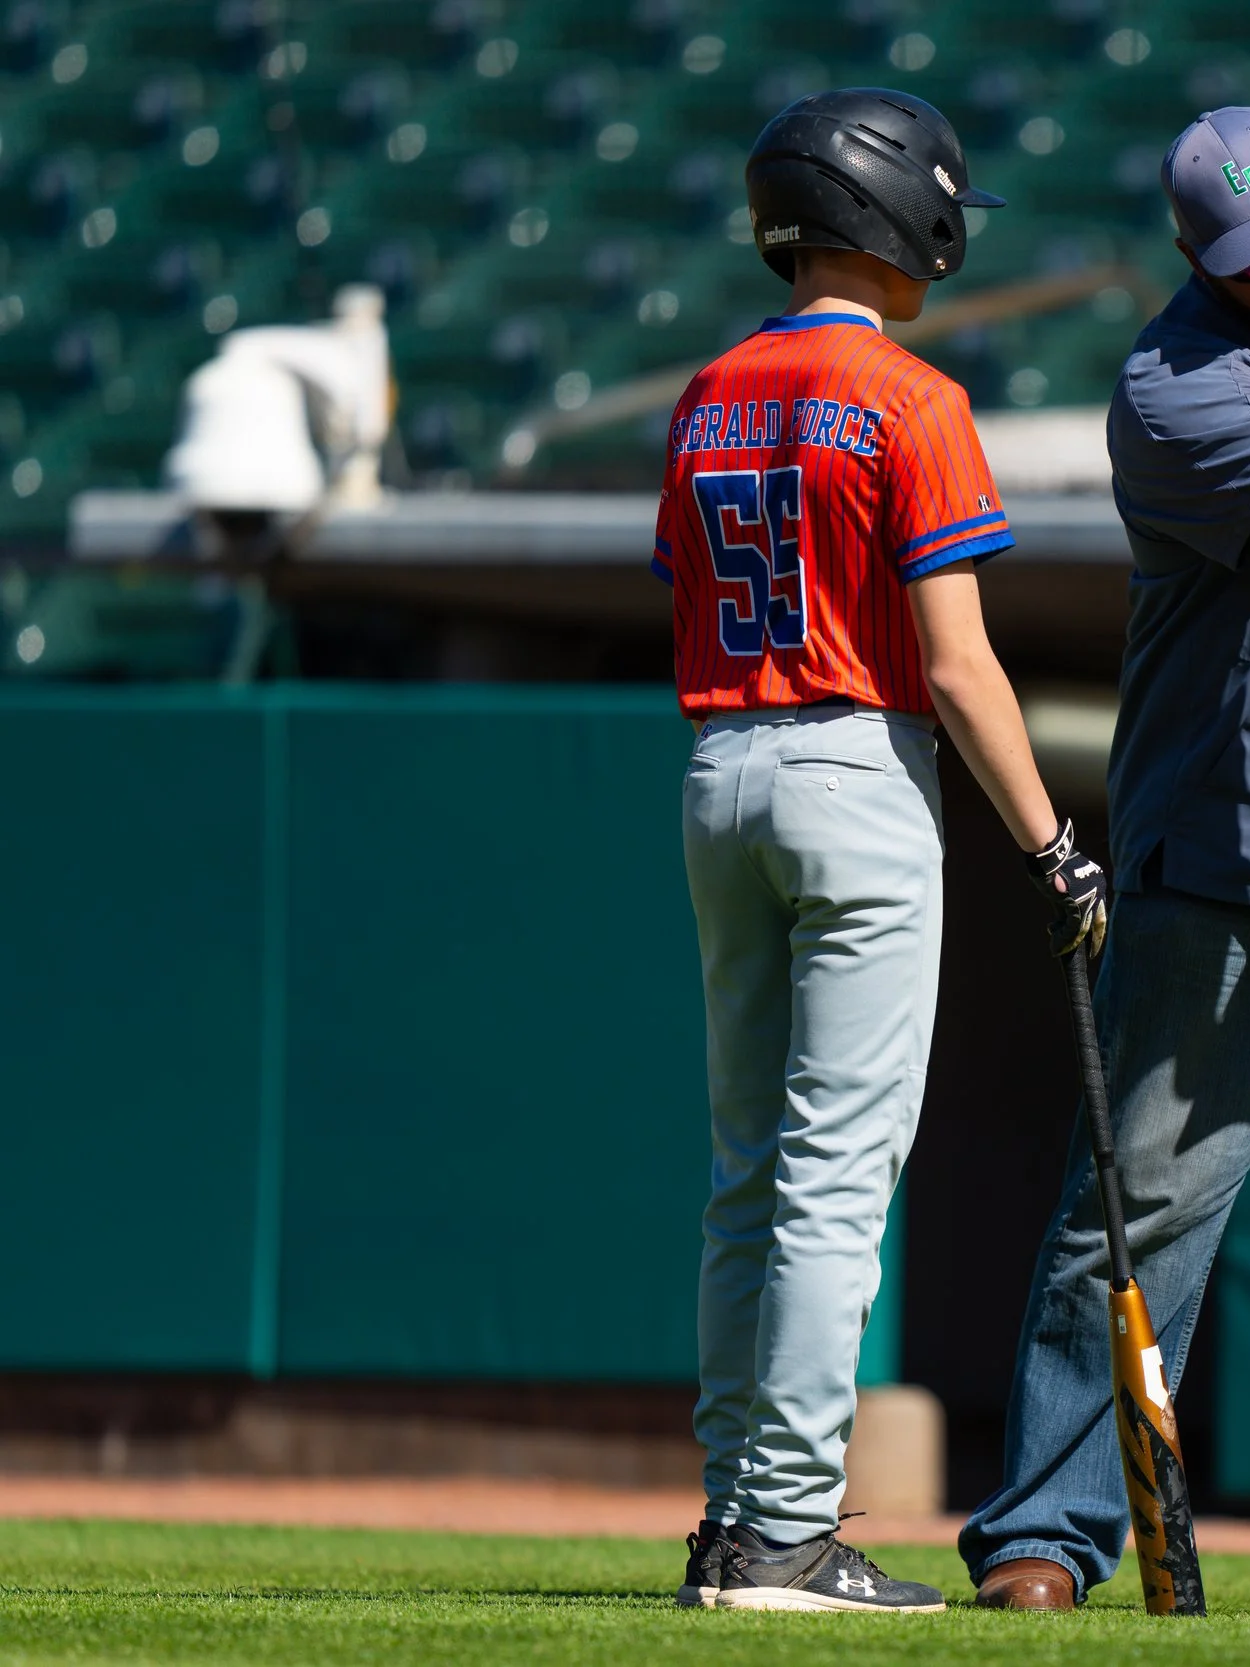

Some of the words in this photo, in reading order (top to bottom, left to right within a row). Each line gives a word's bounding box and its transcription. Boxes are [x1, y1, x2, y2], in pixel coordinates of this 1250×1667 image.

[933, 165, 956, 197] schutt
[764, 224, 800, 244] schutt
[671, 400, 782, 466] ERALD
[786, 398, 883, 457] FORCE
[692, 465, 808, 657] 55
